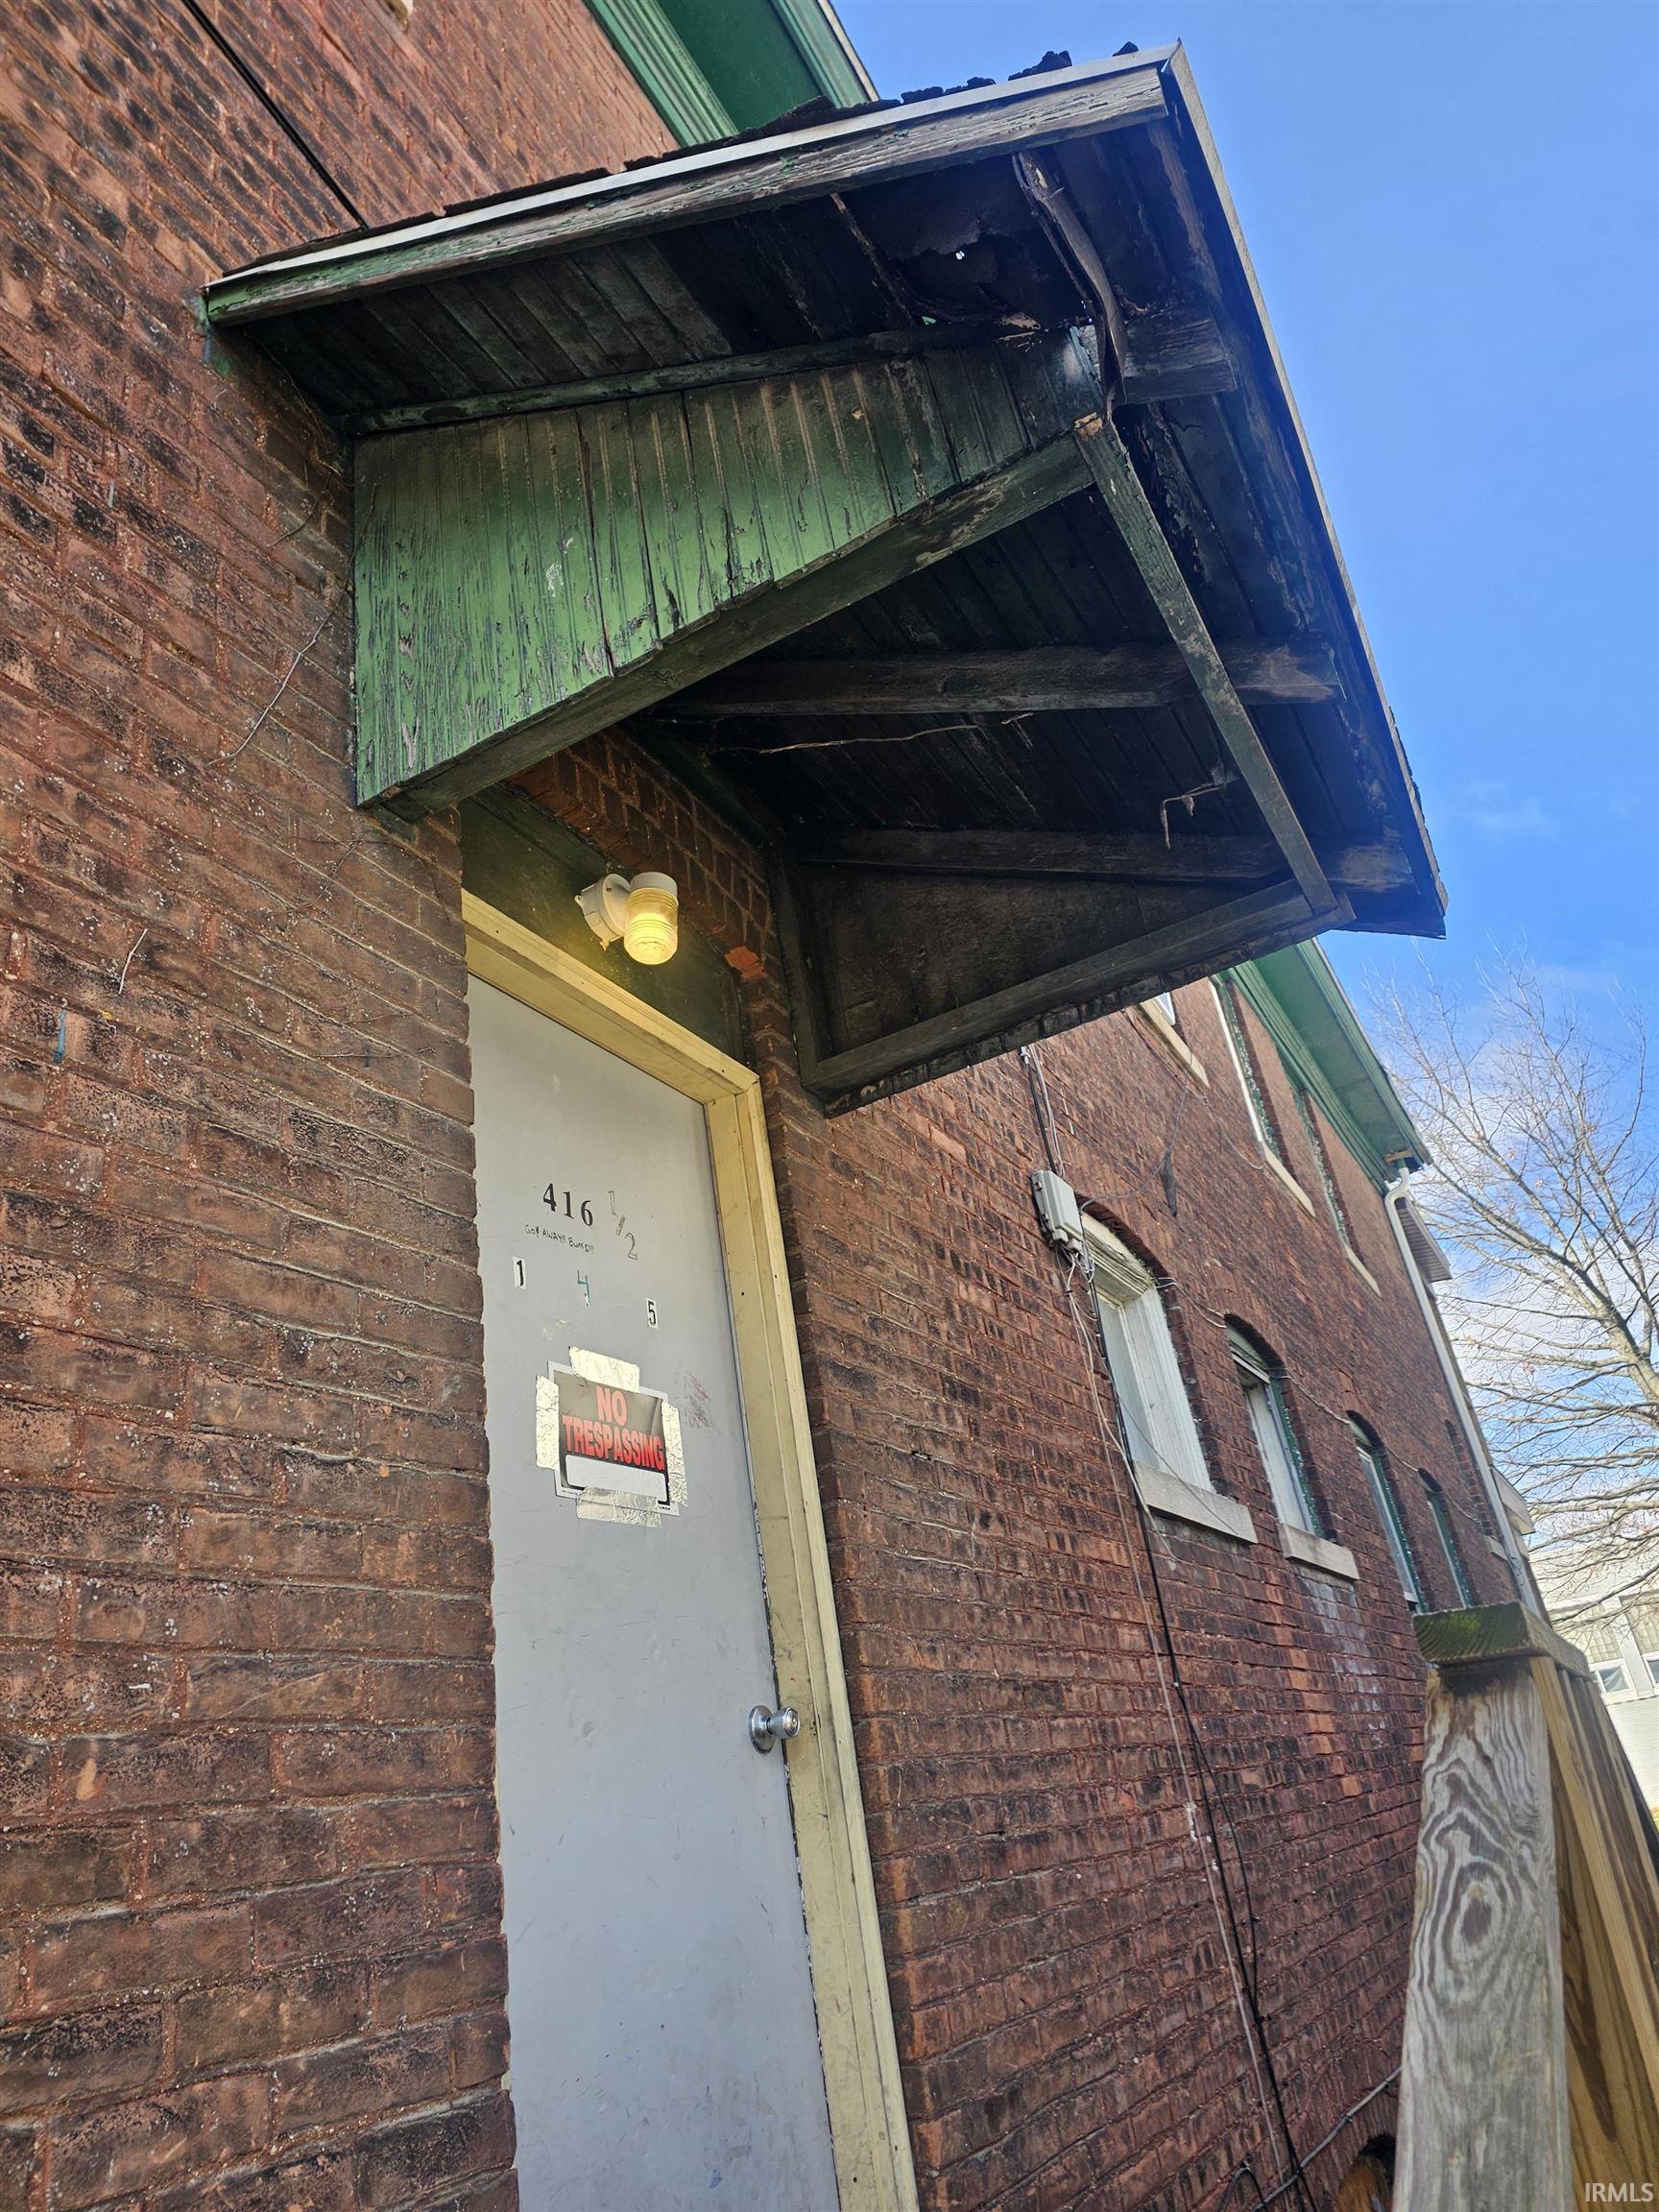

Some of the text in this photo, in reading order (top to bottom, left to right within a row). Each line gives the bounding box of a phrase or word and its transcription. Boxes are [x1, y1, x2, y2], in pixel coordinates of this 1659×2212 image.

[542, 1183, 593, 1227] 416
[516, 1260, 524, 1287] 1
[577, 1269, 591, 1306] 4
[647, 1300, 657, 1327] 5
[596, 1386, 628, 1427] NO
[562, 1416, 665, 1471] TRESPASSING
